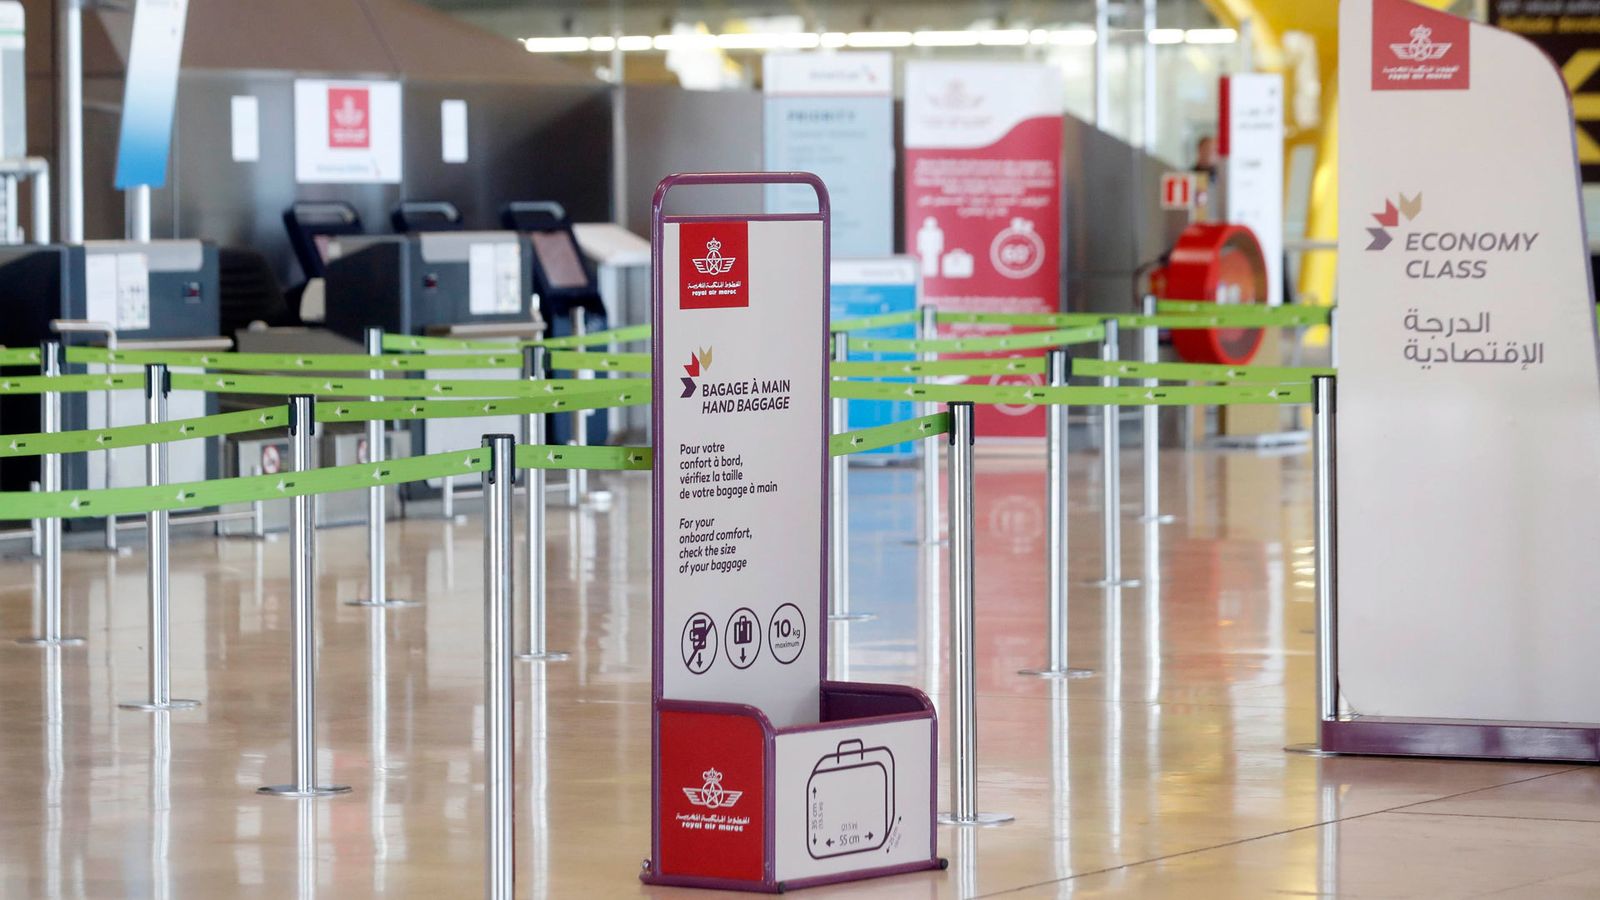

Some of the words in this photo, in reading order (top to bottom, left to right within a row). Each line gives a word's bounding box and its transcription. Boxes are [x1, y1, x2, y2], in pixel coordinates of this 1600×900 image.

[1405, 232, 1539, 252] ECONOMY
[1405, 259, 1488, 279] CLASS
[1403, 308, 1491, 340] الدرجة
[1403, 338, 1545, 371] الإقتصادية
[702, 382, 749, 398] BAGAGE
[751, 378, 760, 395] À
[761, 379, 791, 394] MAIN
[702, 400, 735, 415] HAND
[737, 396, 791, 412] BAGGAGE
[680, 444, 700, 456] Pour
[702, 442, 725, 455] votre
[680, 456, 712, 470] confort
[713, 457, 720, 468] à
[721, 455, 743, 468] bord,
[680, 470, 711, 485] vérifiez
[712, 470, 720, 483] la
[721, 469, 743, 482] taille
[679, 487, 690, 500] de
[692, 487, 715, 499] votre
[716, 485, 748, 500] bagage
[749, 482, 756, 493] à
[756, 481, 778, 493] main
[679, 518, 694, 529] For
[695, 517, 715, 531] your
[679, 529, 714, 545] onboard
[716, 527, 753, 542] comfort,
[679, 546, 703, 559] check
[704, 544, 718, 557] the
[720, 543, 737, 556] size
[679, 560, 689, 575] of
[690, 559, 709, 575] your
[711, 558, 748, 573] baggage
[774, 618, 791, 638] 10
[792, 628, 801, 638] kg
[775, 641, 800, 649] maximum
[682, 821, 702, 831] royal
[718, 824, 744, 832] maroc
[839, 834, 848, 847] 55
[848, 834, 860, 845] cm
